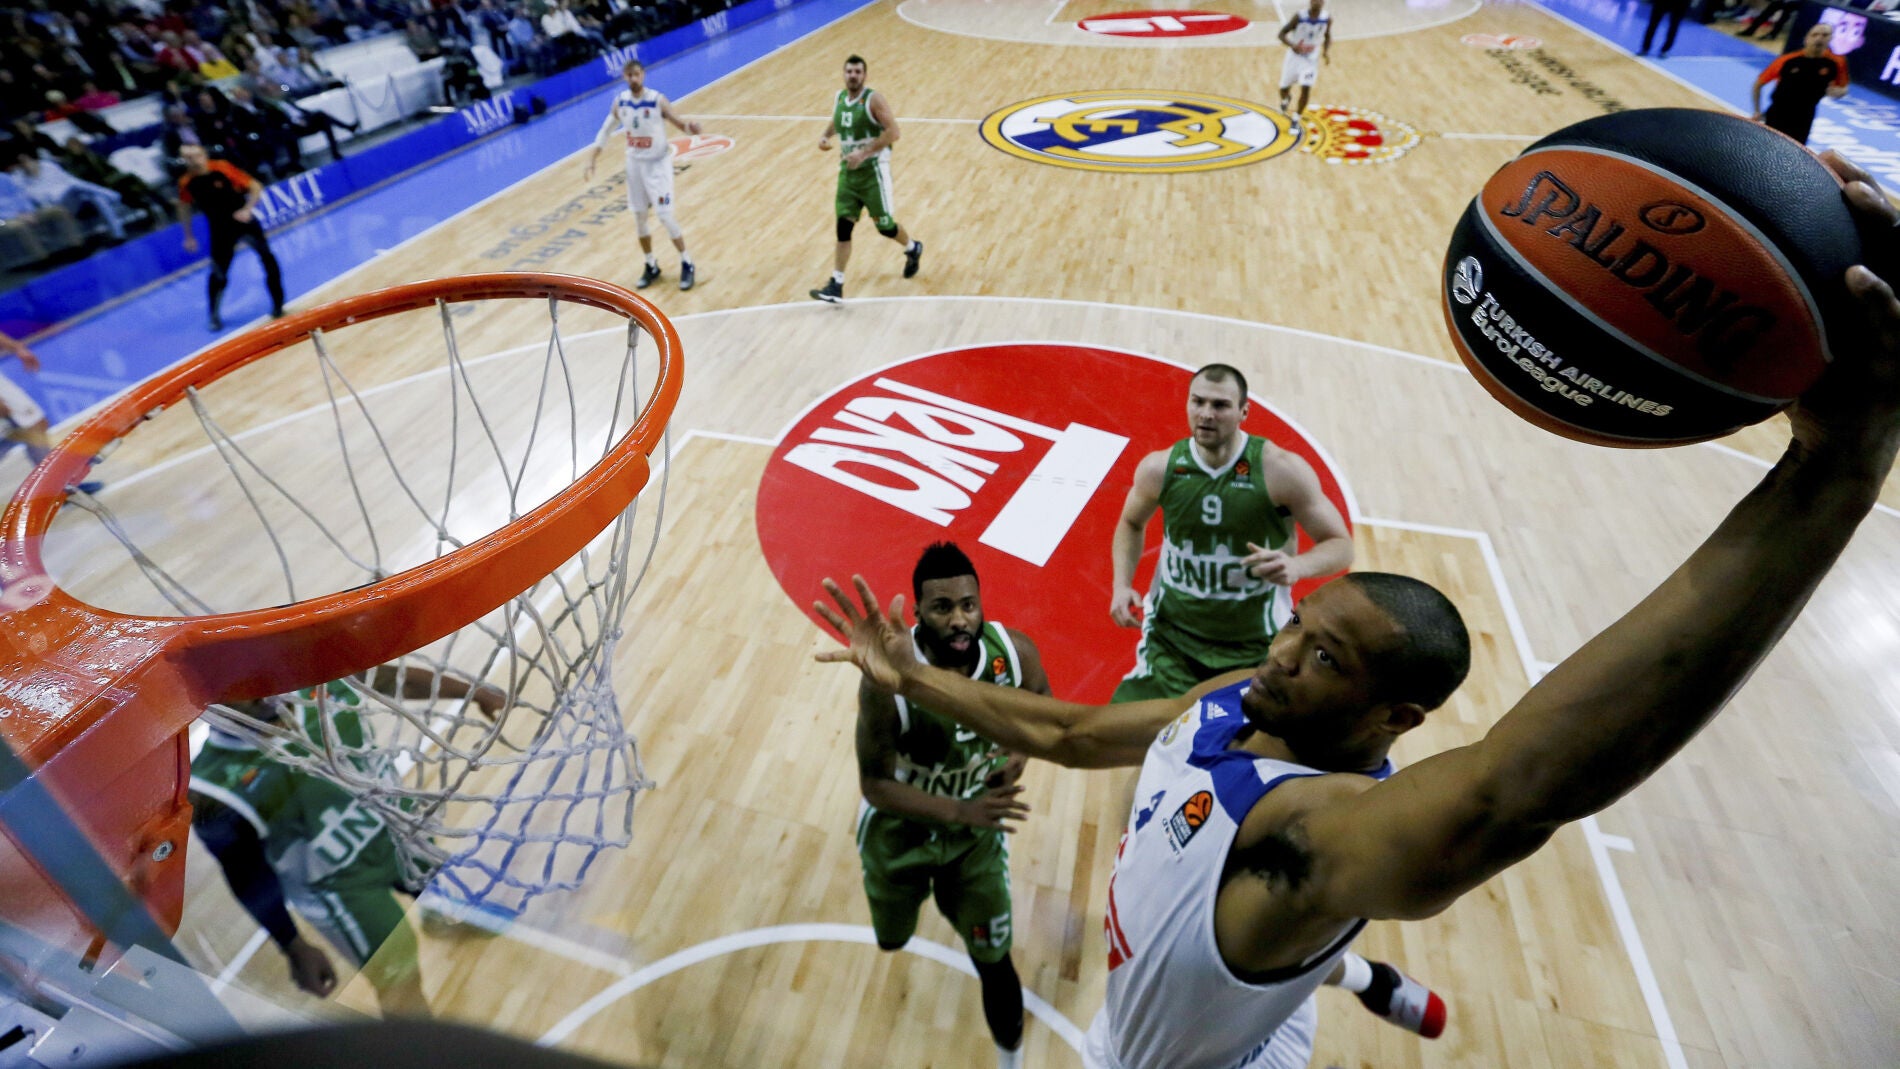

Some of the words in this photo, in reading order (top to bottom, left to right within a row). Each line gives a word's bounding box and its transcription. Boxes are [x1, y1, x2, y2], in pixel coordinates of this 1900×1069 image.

[841, 111, 853, 128] 13
[1500, 170, 1778, 376] SPALDING
[1482, 292, 1572, 370] TURKISH
[1561, 364, 1675, 418] AIRLINES
[1201, 494, 1223, 526] 9
[906, 757, 992, 801] UNIC
[990, 912, 1010, 949] 5
